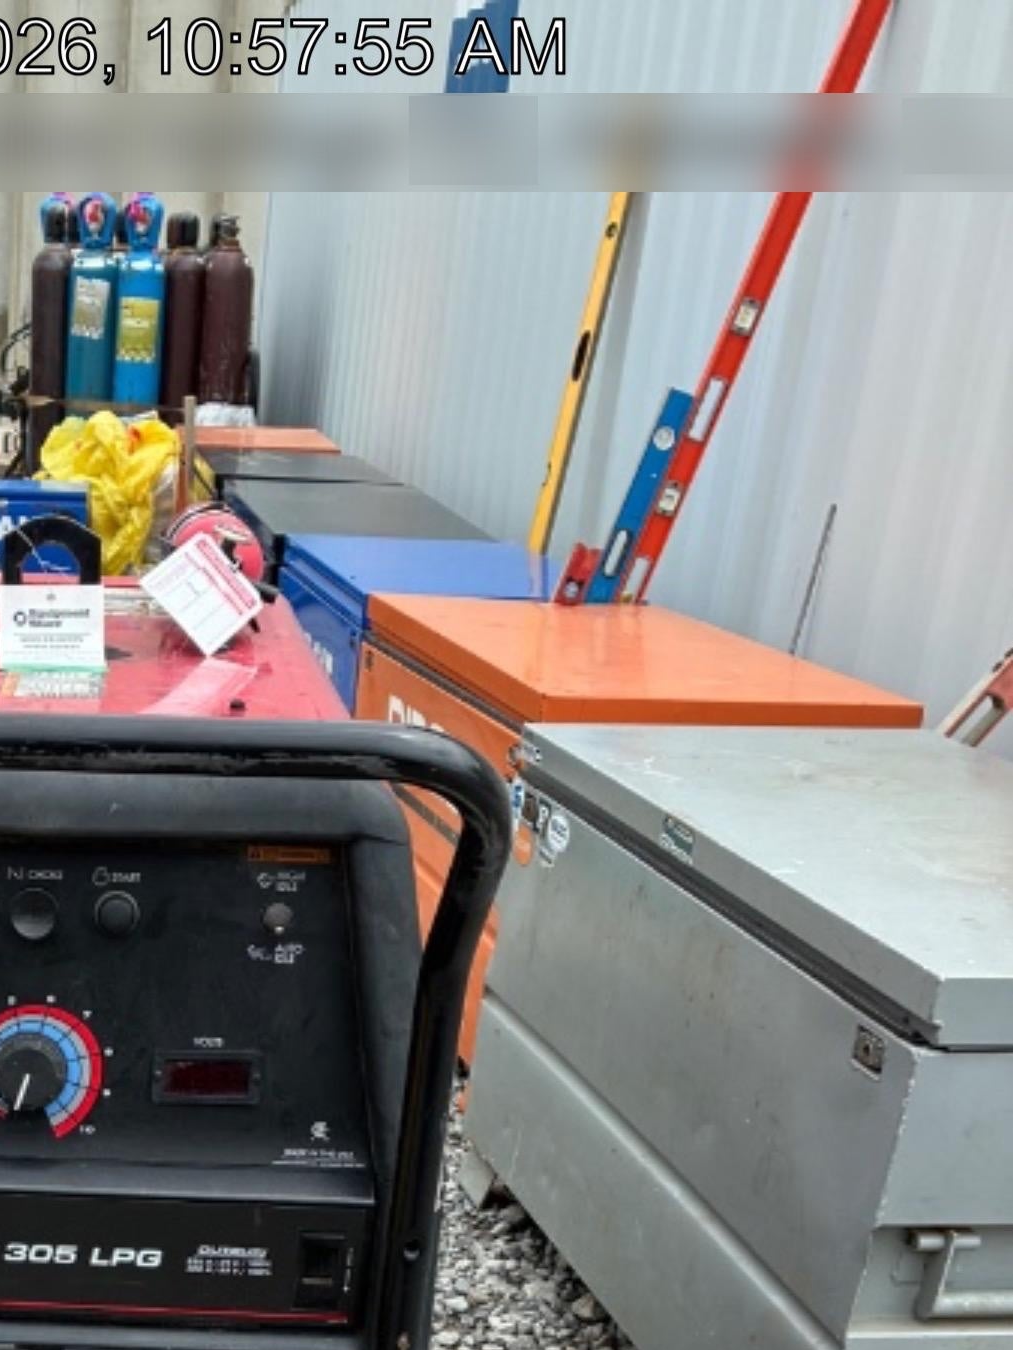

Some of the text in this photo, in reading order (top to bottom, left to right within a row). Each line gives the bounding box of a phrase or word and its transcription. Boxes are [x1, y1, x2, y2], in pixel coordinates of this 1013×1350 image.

[111, 871, 141, 883] START
[4, 1242, 78, 1264] 305
[89, 1247, 163, 1268] LPG
